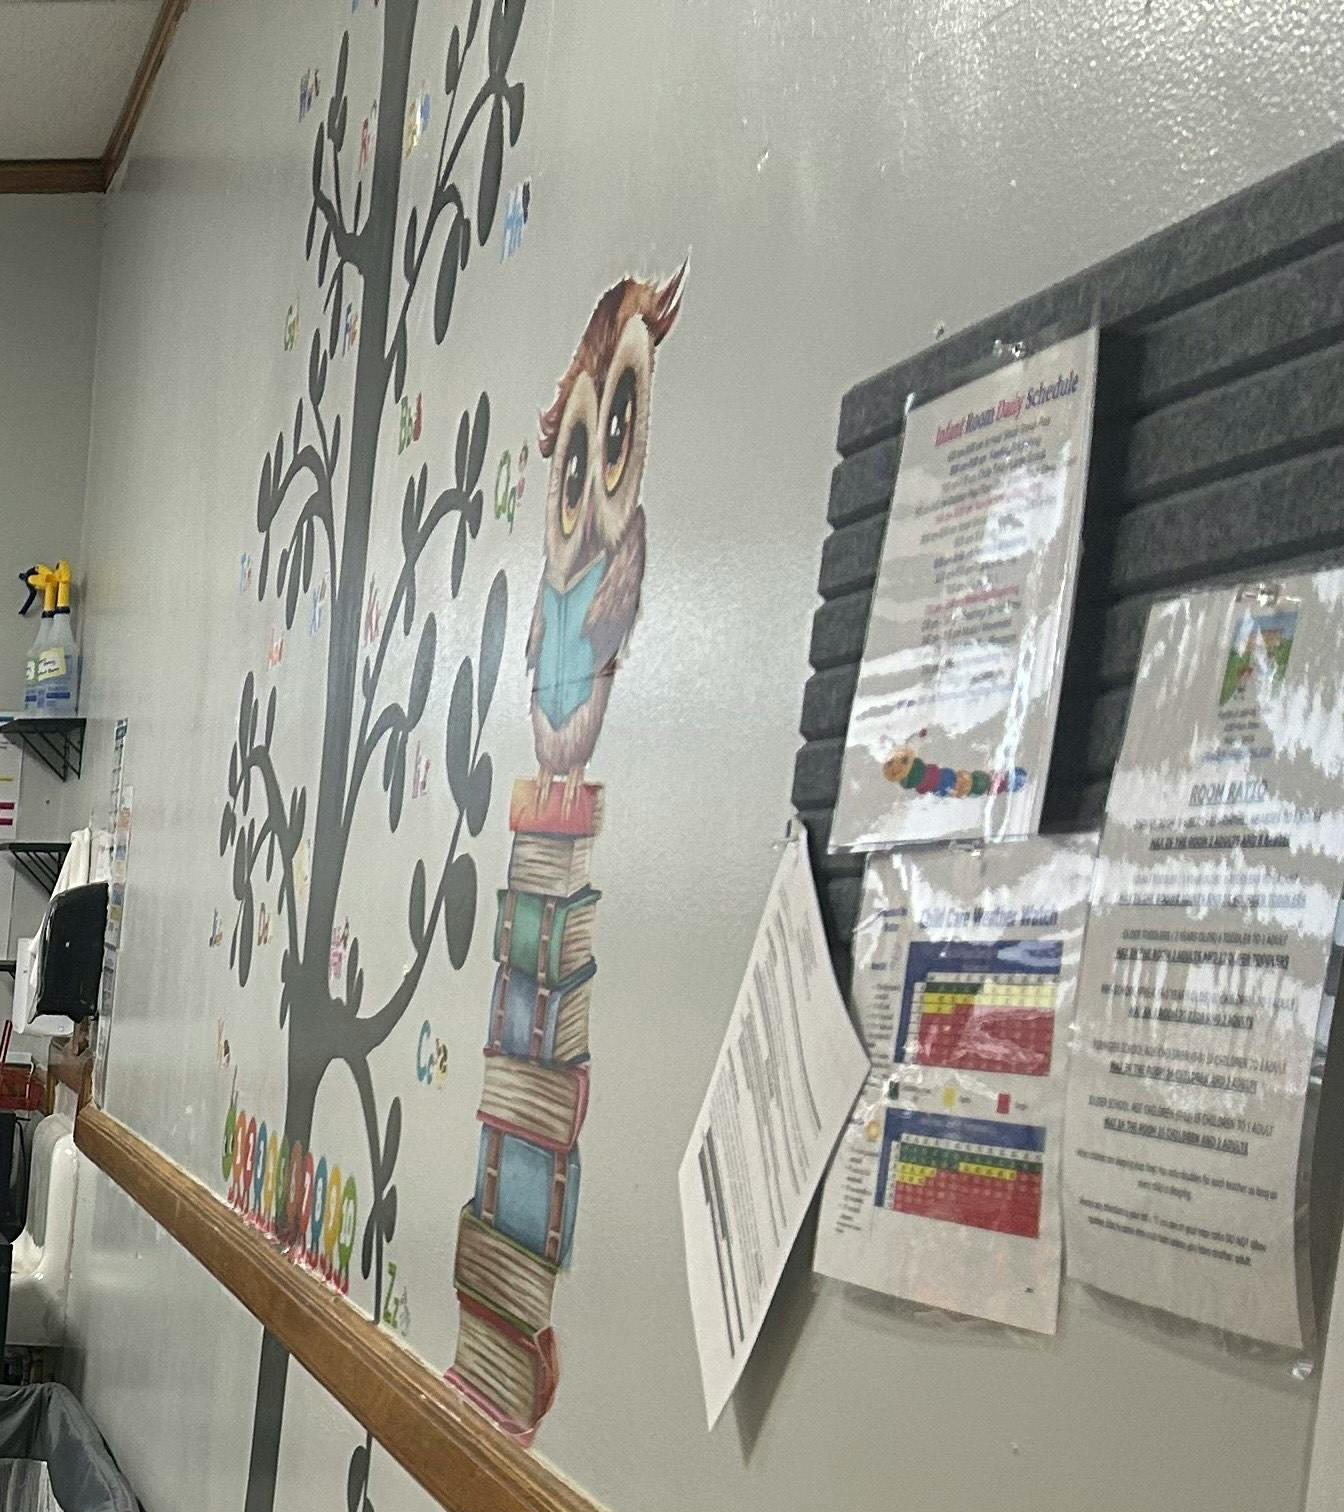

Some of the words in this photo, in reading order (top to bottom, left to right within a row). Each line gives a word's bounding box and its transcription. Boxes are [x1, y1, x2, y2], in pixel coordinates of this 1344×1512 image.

[934, 417, 966, 447] Infant
[965, 405, 995, 435] Room
[995, 391, 1026, 421] Daily
[1025, 371, 1079, 410] Schedule
[1190, 783, 1225, 804] ROOM
[340, 1196, 354, 1247] 10
